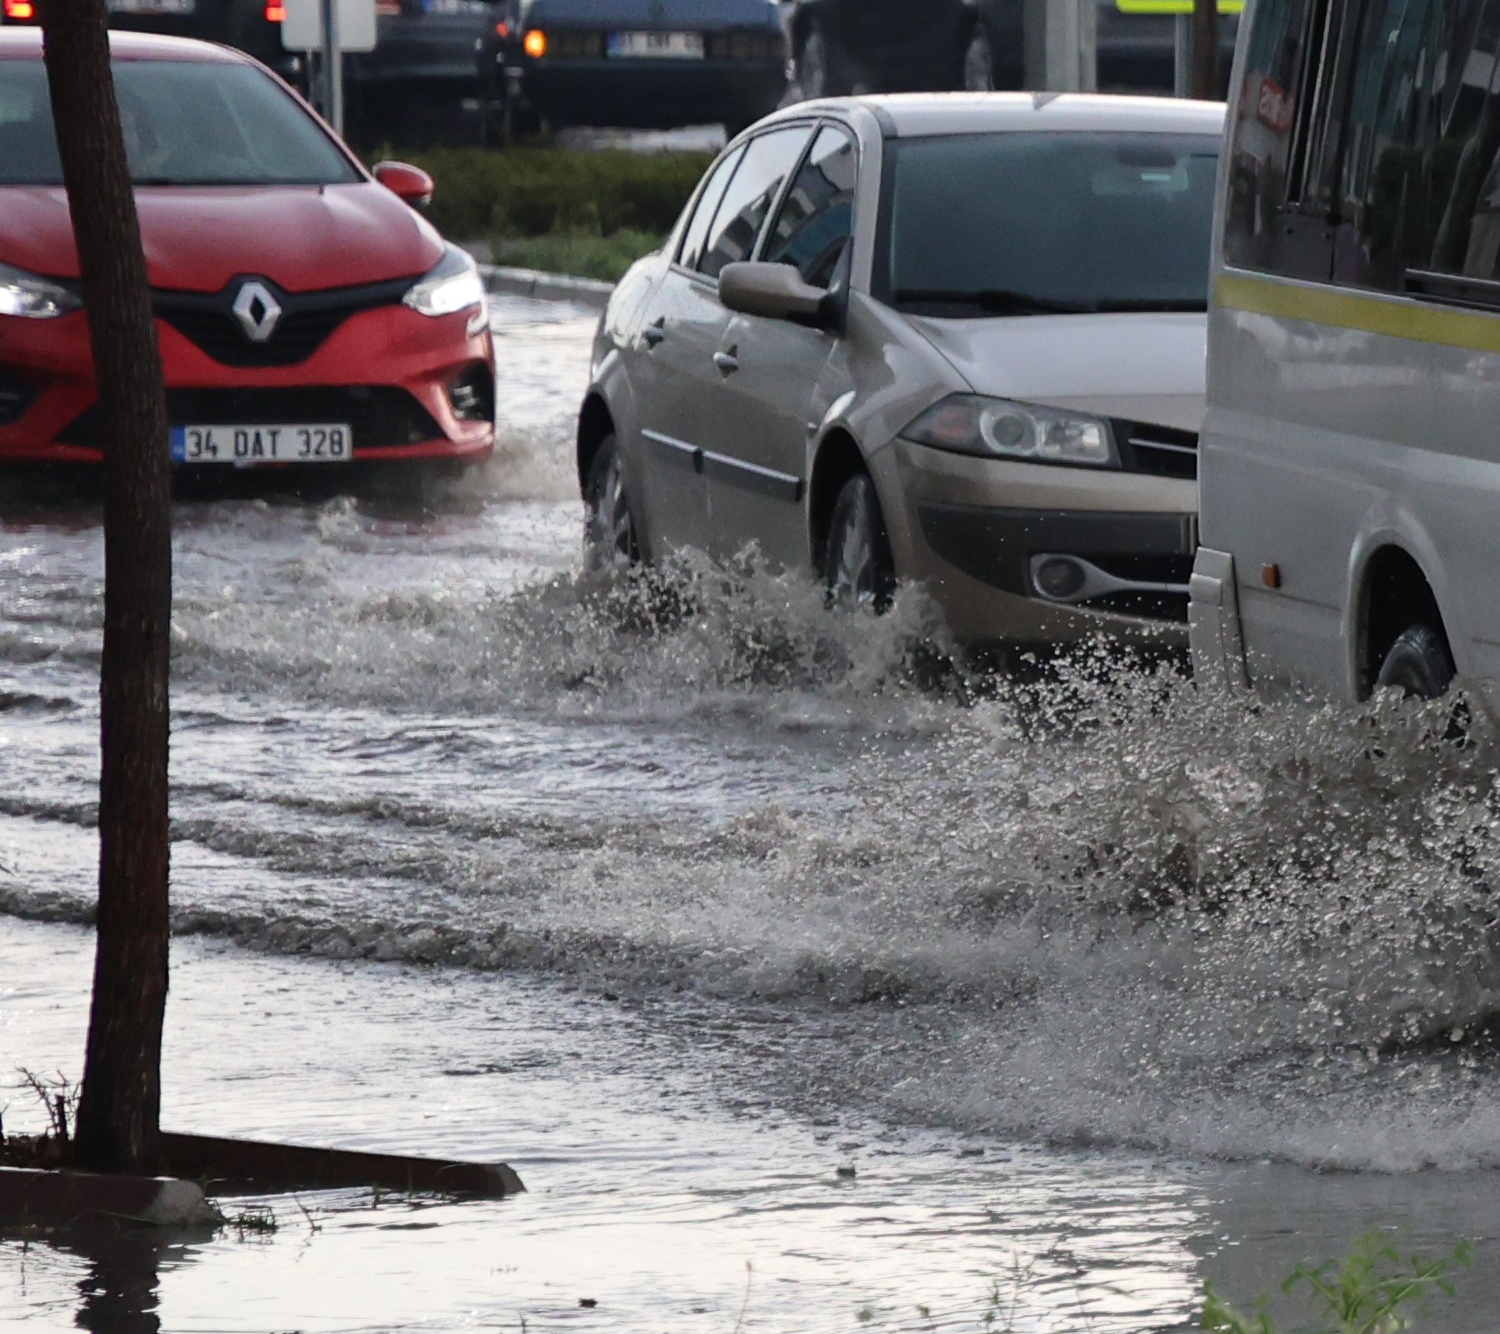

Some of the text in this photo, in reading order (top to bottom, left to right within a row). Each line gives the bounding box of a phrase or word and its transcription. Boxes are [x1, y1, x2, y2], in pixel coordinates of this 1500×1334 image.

[189, 430, 343, 457] 34 DAT 328
